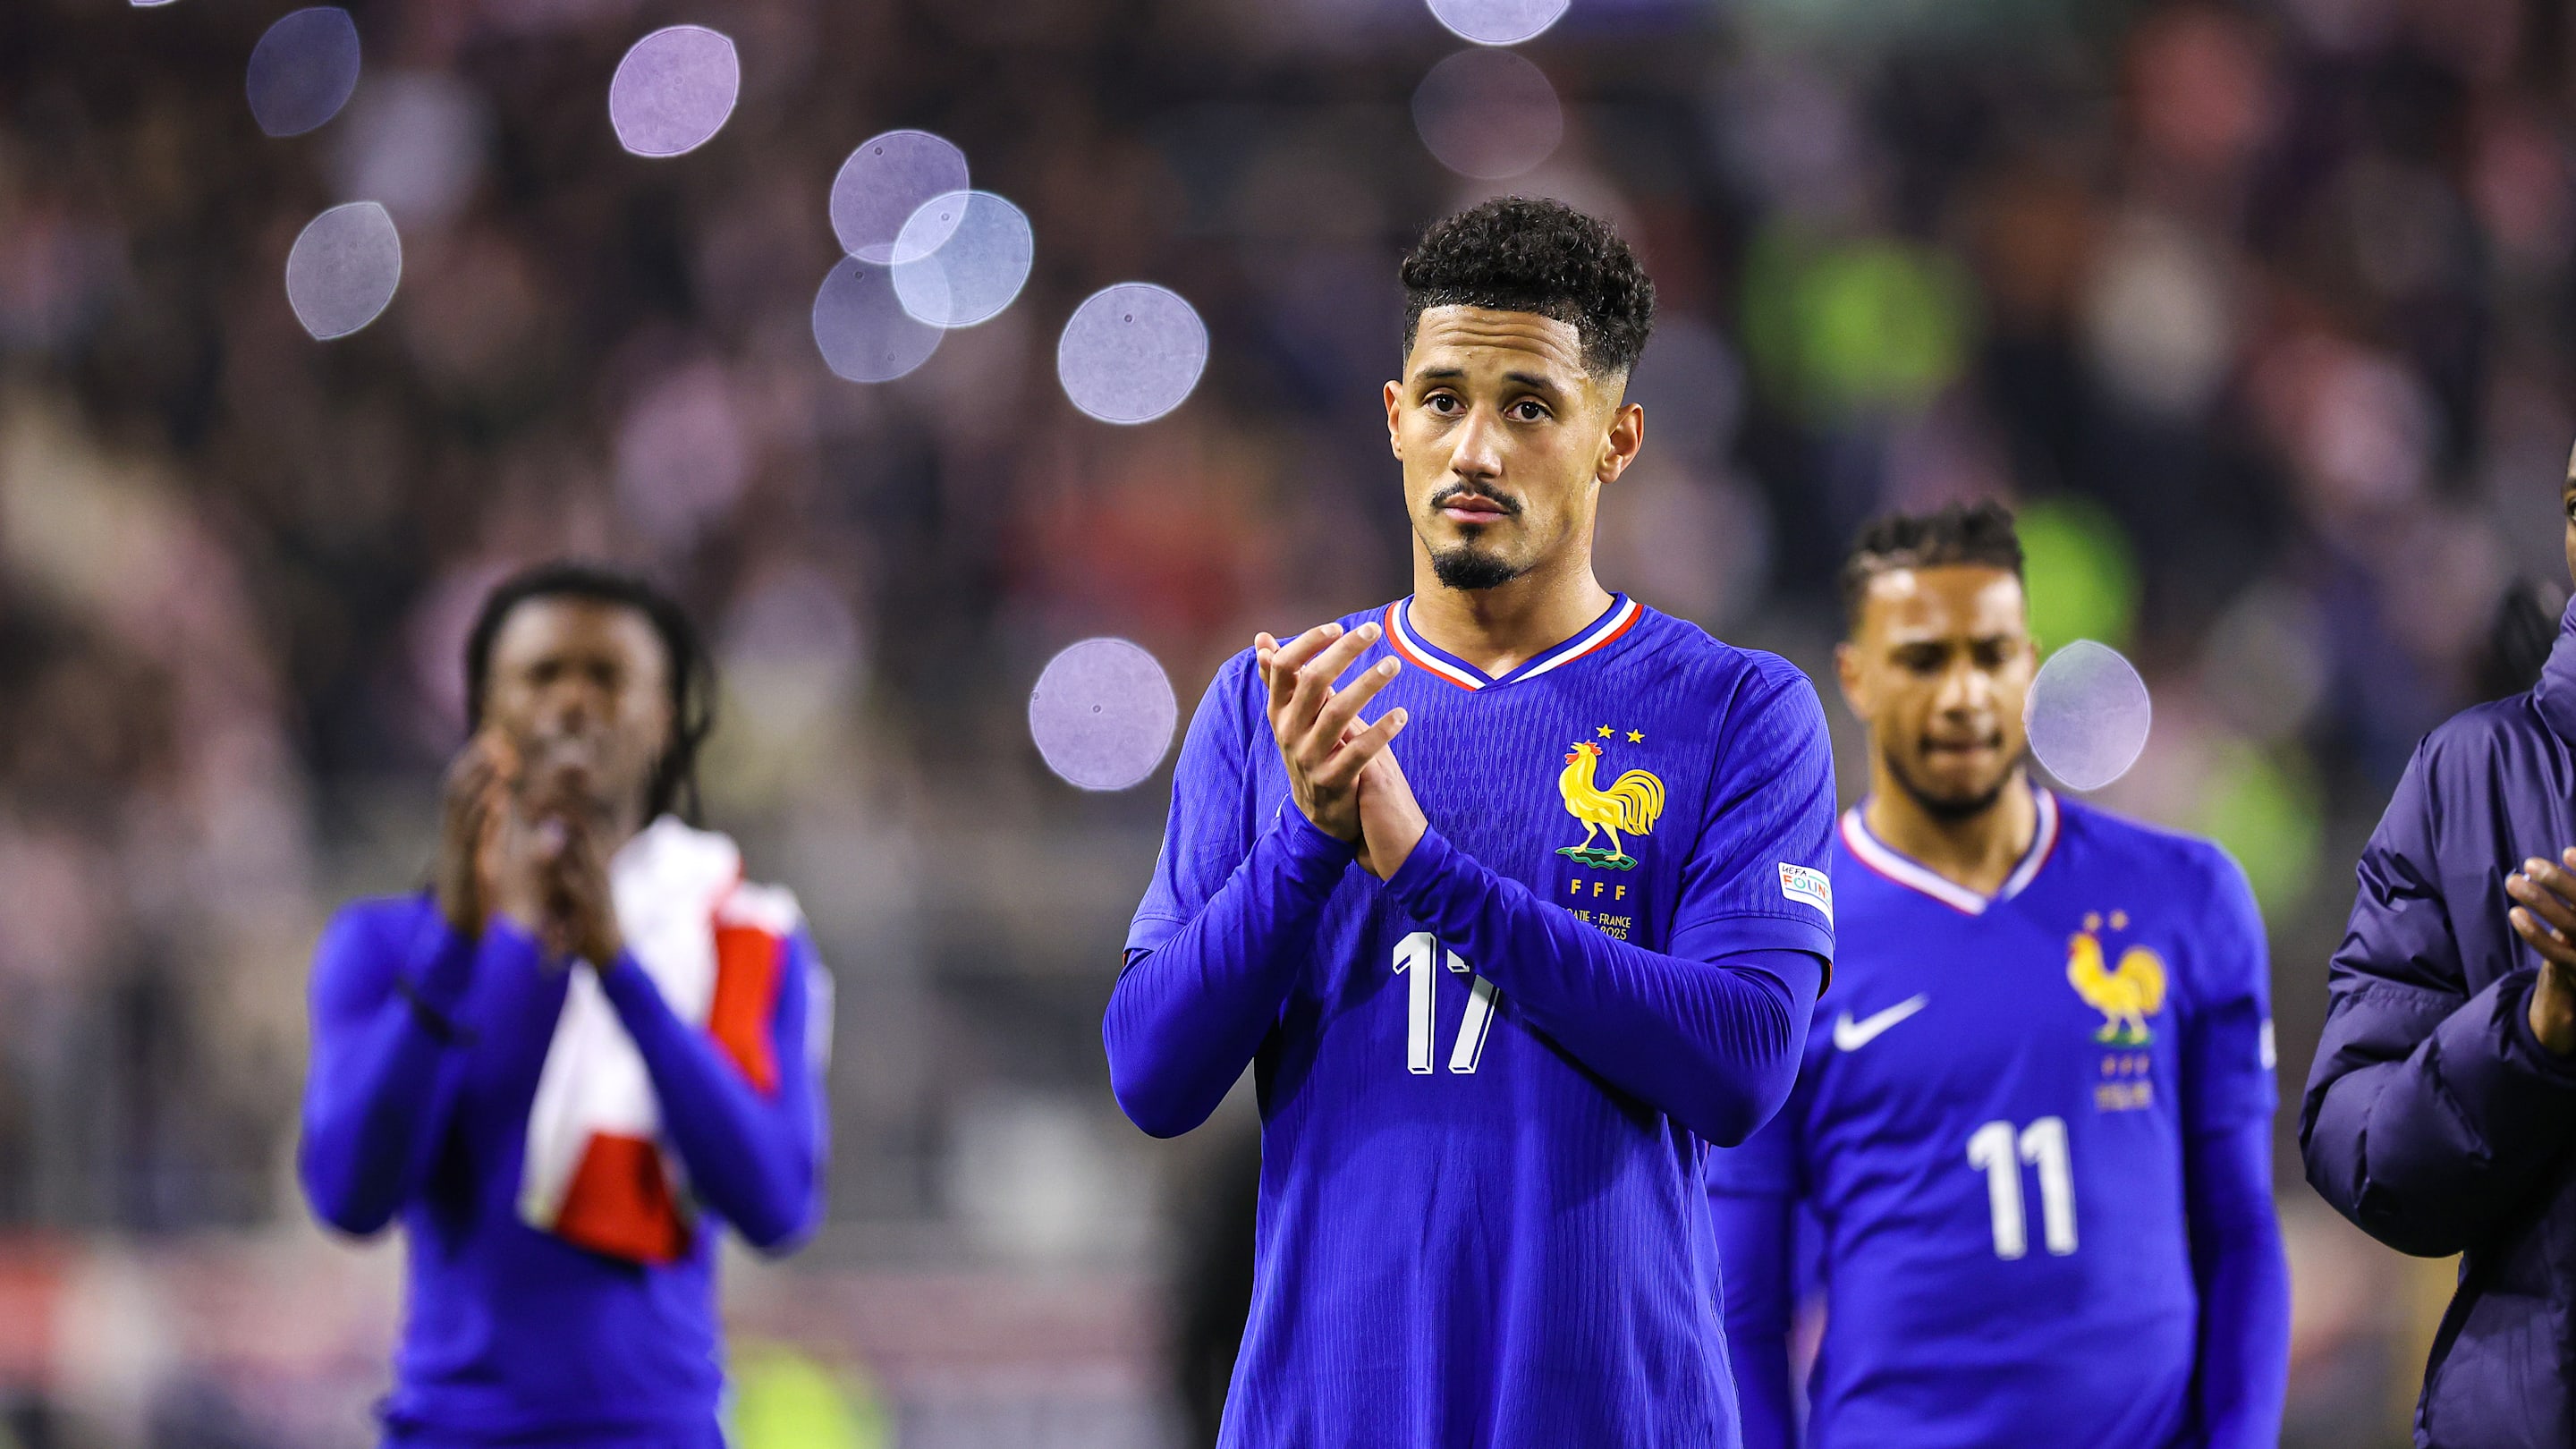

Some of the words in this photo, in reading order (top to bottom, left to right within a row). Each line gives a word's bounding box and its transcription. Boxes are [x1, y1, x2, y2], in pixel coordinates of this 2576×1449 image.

[1782, 866, 1807, 877] UEFA
[1598, 912, 1631, 928] FRANCE
[1392, 931, 1501, 1075] 17
[1967, 1116, 2079, 1260] 11
